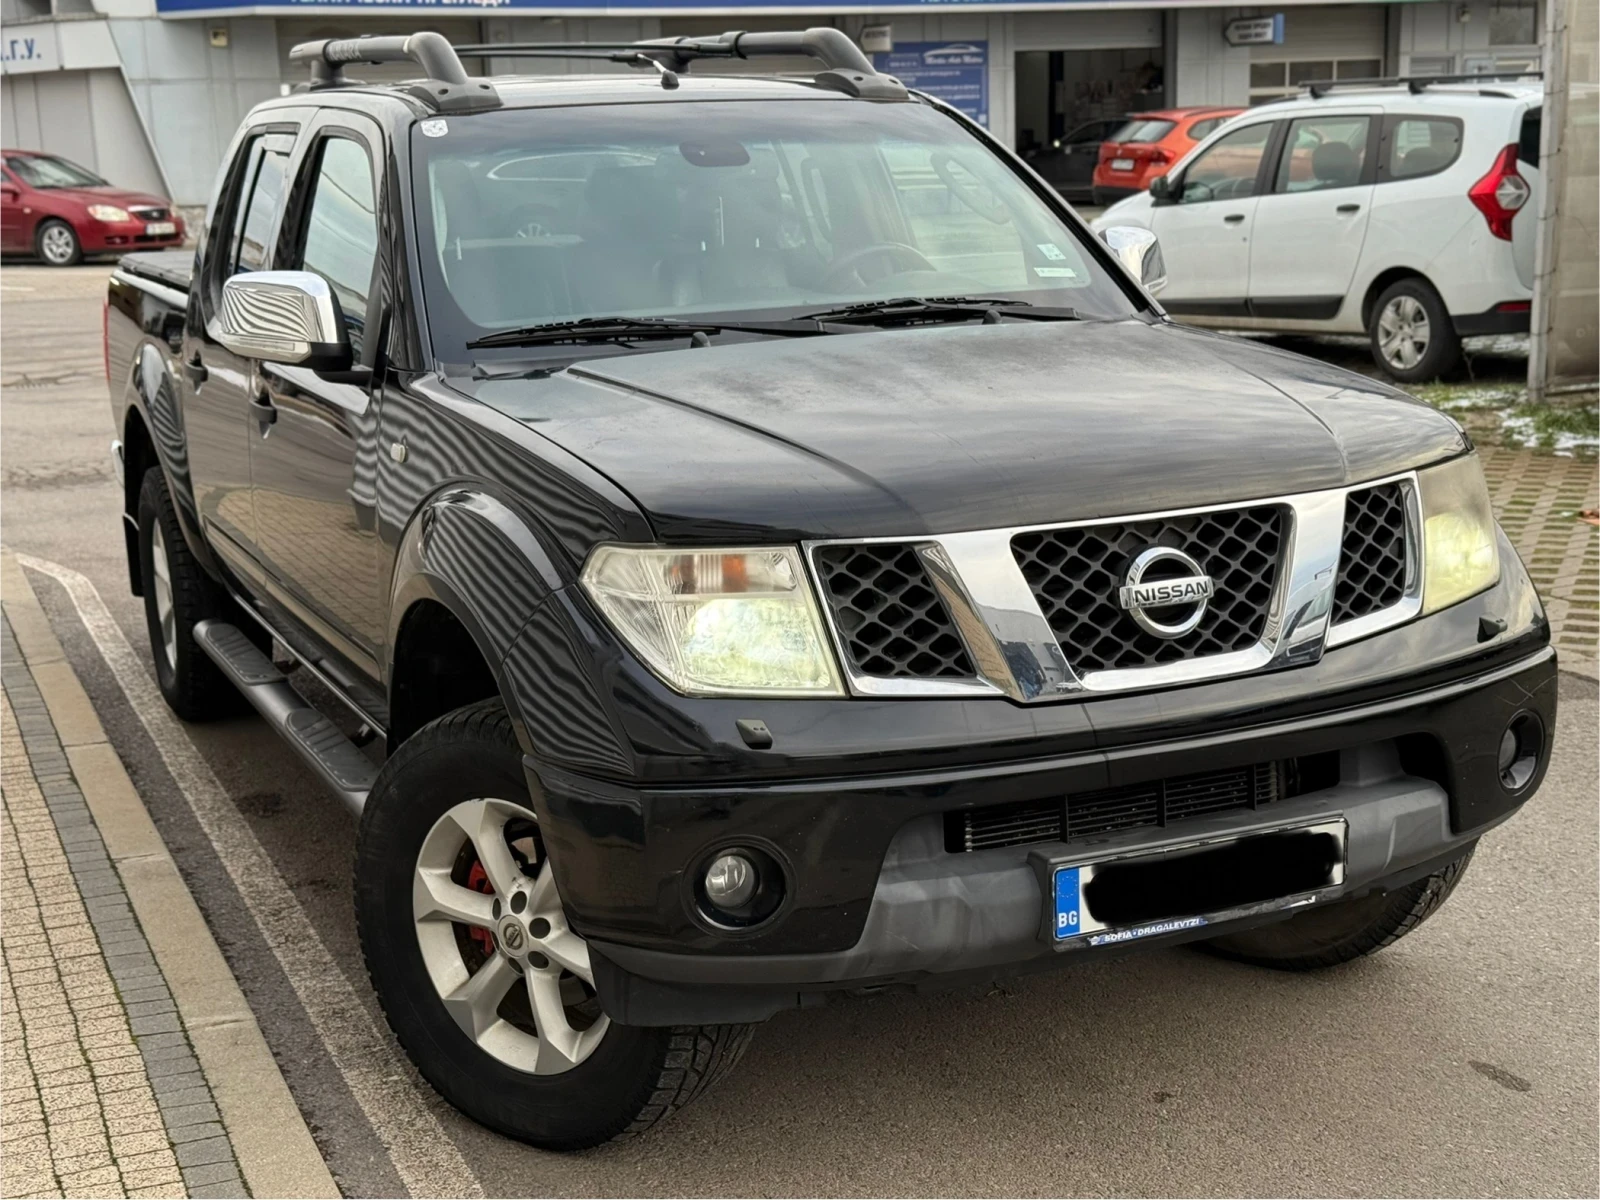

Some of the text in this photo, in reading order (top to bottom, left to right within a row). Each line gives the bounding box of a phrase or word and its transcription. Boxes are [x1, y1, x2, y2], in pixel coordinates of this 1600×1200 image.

[0, 38, 42, 61] .Г.У.
[1134, 580, 1208, 603] NISSAN
[1058, 910, 1078, 928] BG
